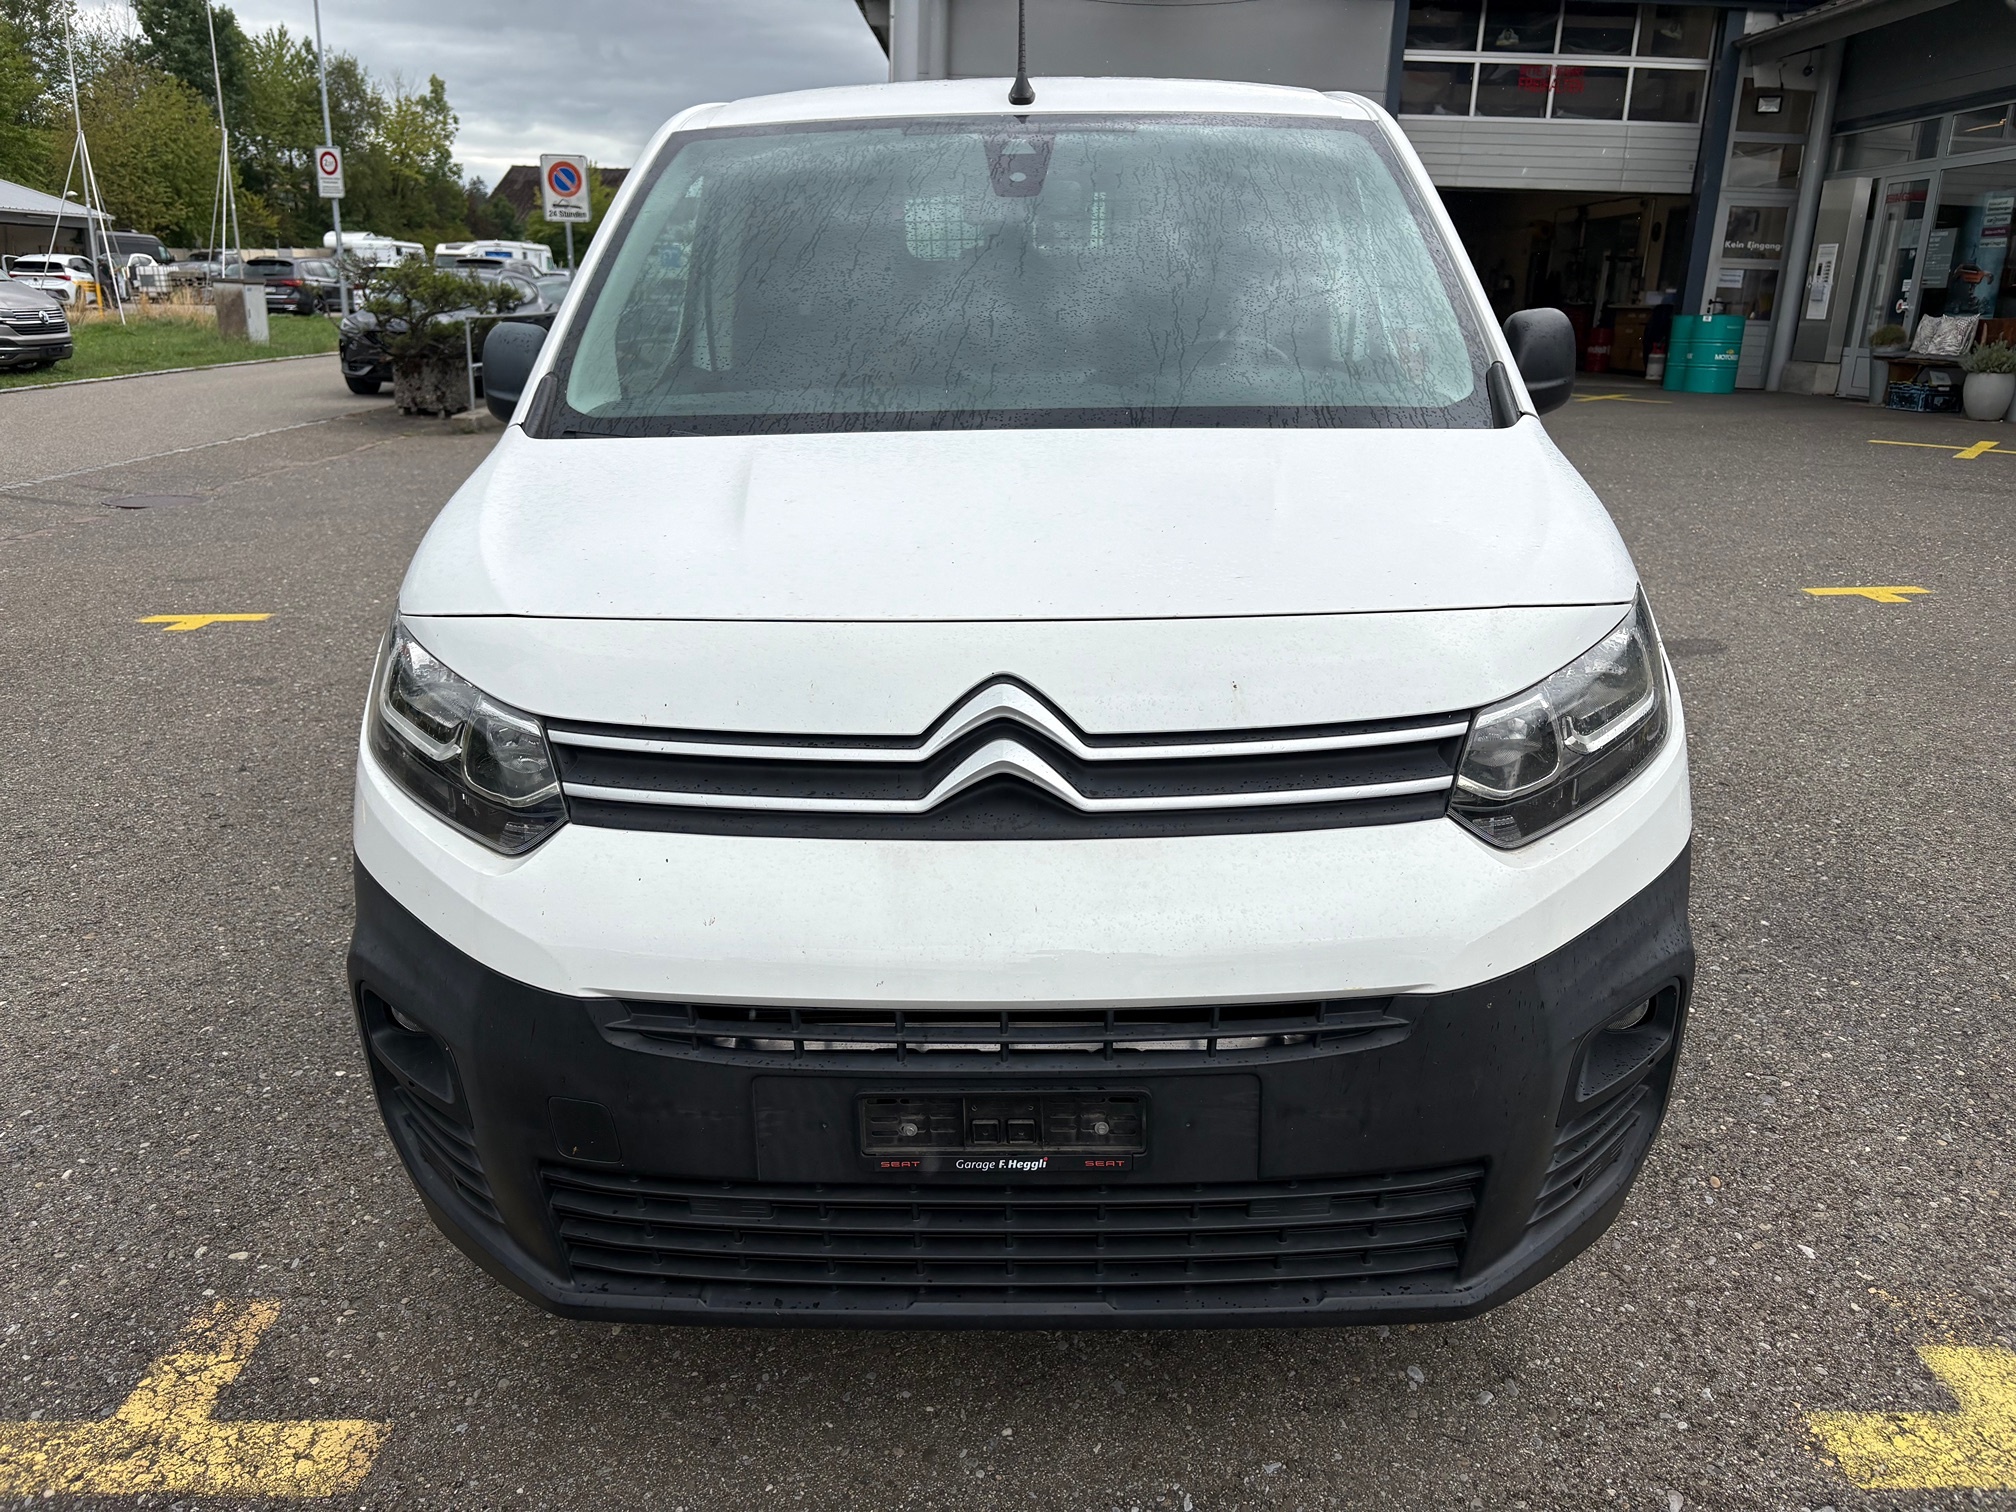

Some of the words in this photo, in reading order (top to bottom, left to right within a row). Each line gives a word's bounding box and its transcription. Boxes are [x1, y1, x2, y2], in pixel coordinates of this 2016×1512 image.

[549, 210, 557, 218] 24
[559, 210, 588, 218] Stunden
[1724, 240, 1745, 249] Kein
[1747, 241, 1782, 252] Eingang
[955, 1159, 996, 1172] Garage
[1084, 1160, 1125, 1168] SEAT
